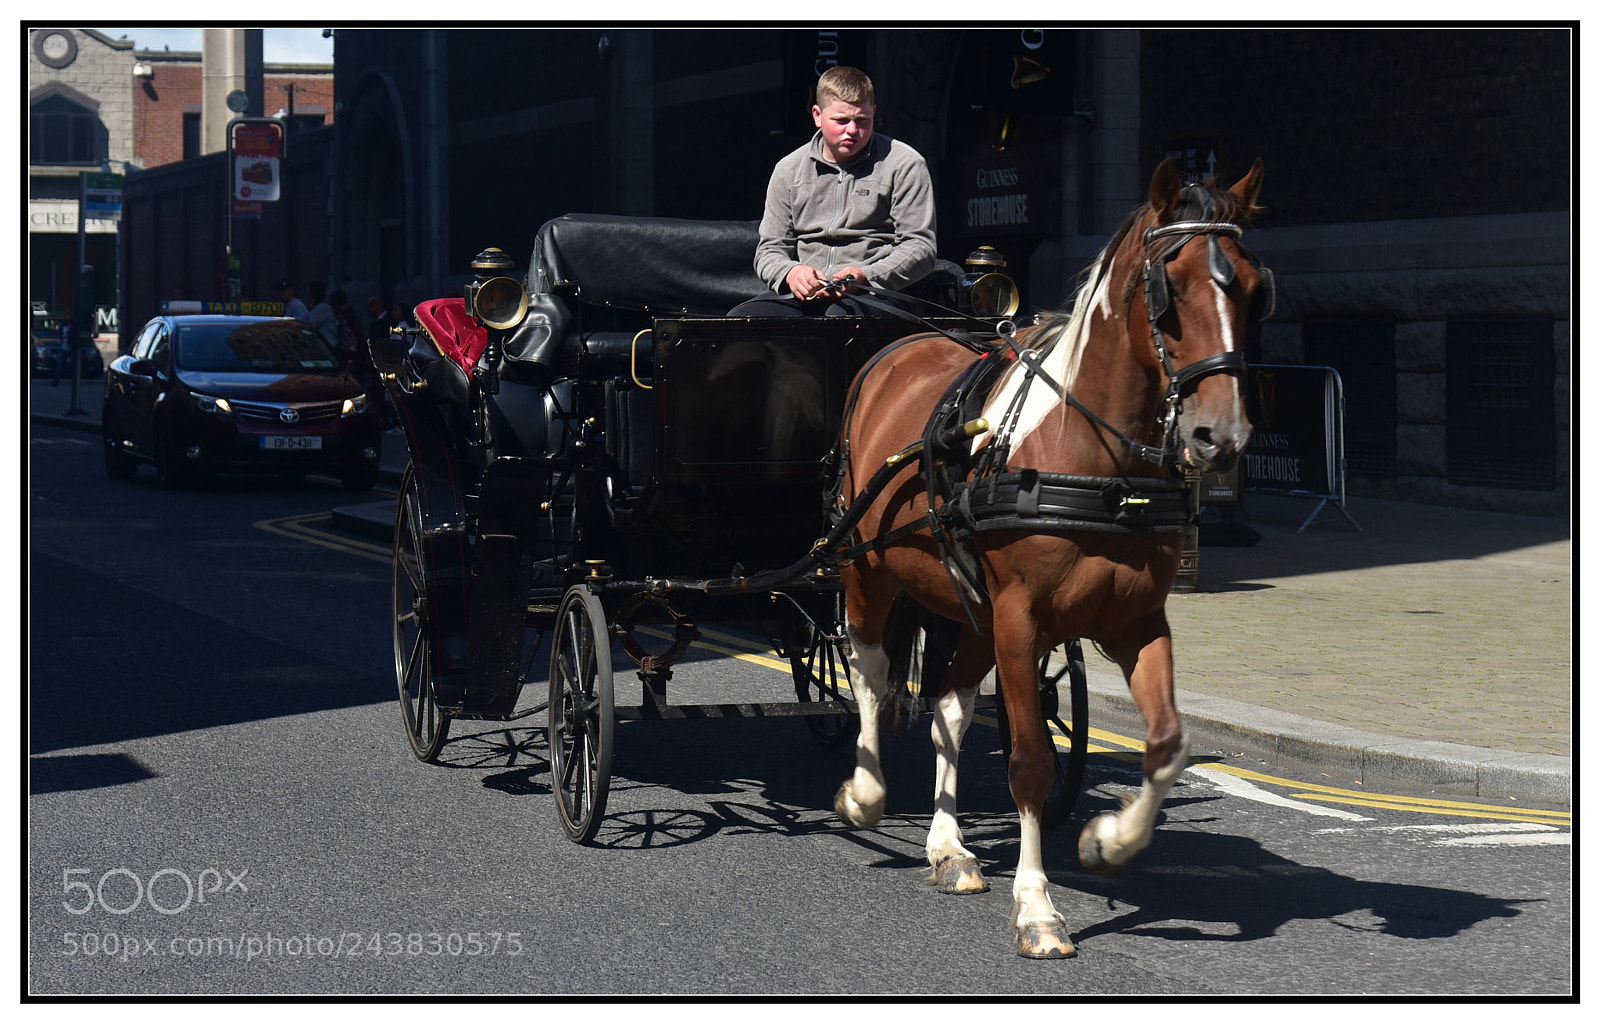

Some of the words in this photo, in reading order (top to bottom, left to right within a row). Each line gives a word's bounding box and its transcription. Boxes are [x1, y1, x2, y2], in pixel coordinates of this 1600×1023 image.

[977, 167, 1019, 189] GUINNESS
[967, 193, 1029, 228] STOREHOUSE
[207, 302, 237, 314] TAXI
[1245, 454, 1301, 483] TOREHOUSE
